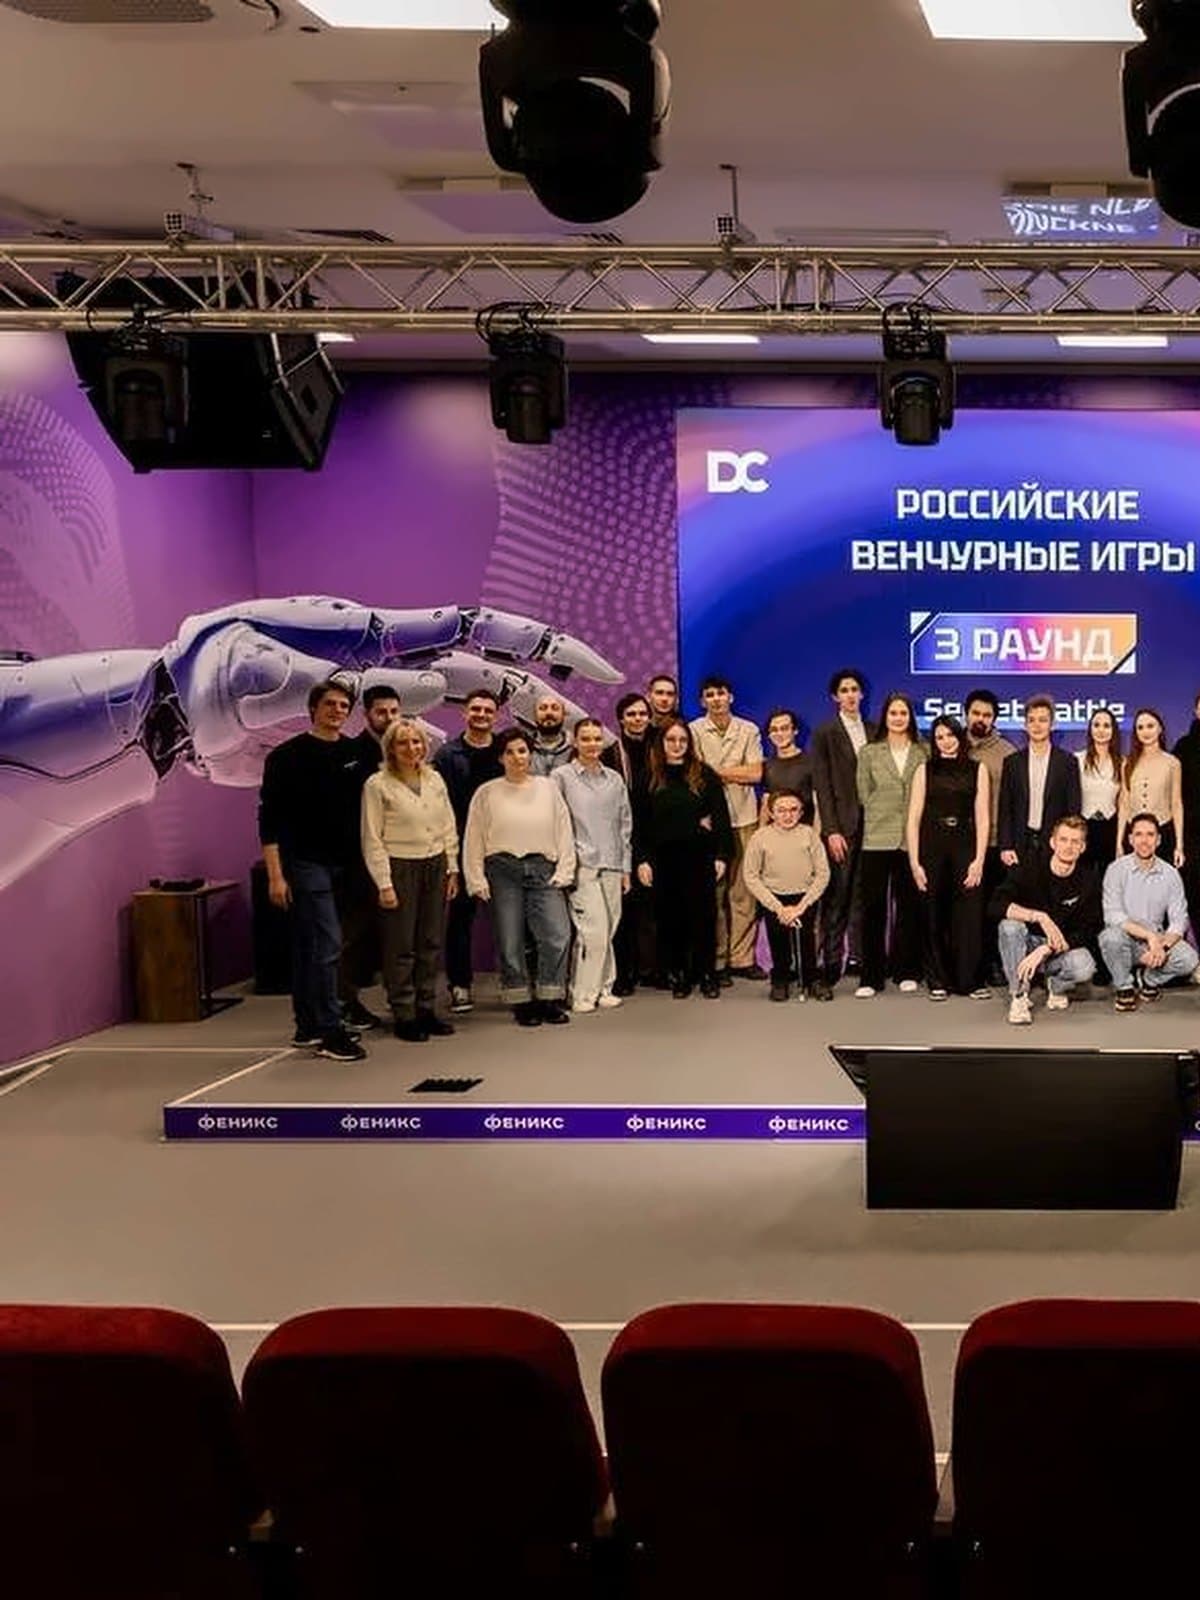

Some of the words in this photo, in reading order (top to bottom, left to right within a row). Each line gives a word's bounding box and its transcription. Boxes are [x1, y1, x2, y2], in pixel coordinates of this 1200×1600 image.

[707, 450, 769, 493] DC
[897, 482, 1139, 520] РОССИЙСКИЕ
[852, 541, 1080, 571] ВЕНЧУРНЫЕ
[1092, 542, 1195, 571] ИГРЫ
[934, 628, 961, 661] 3
[972, 628, 1114, 665] РАУНД
[199, 1114, 277, 1130] ФЕНИКС
[341, 1115, 420, 1131] ФЕНИКС
[484, 1115, 563, 1131] ФЕНИКС
[627, 1115, 705, 1131] ФЕНИКС
[769, 1116, 848, 1132] ФЕНИКС
